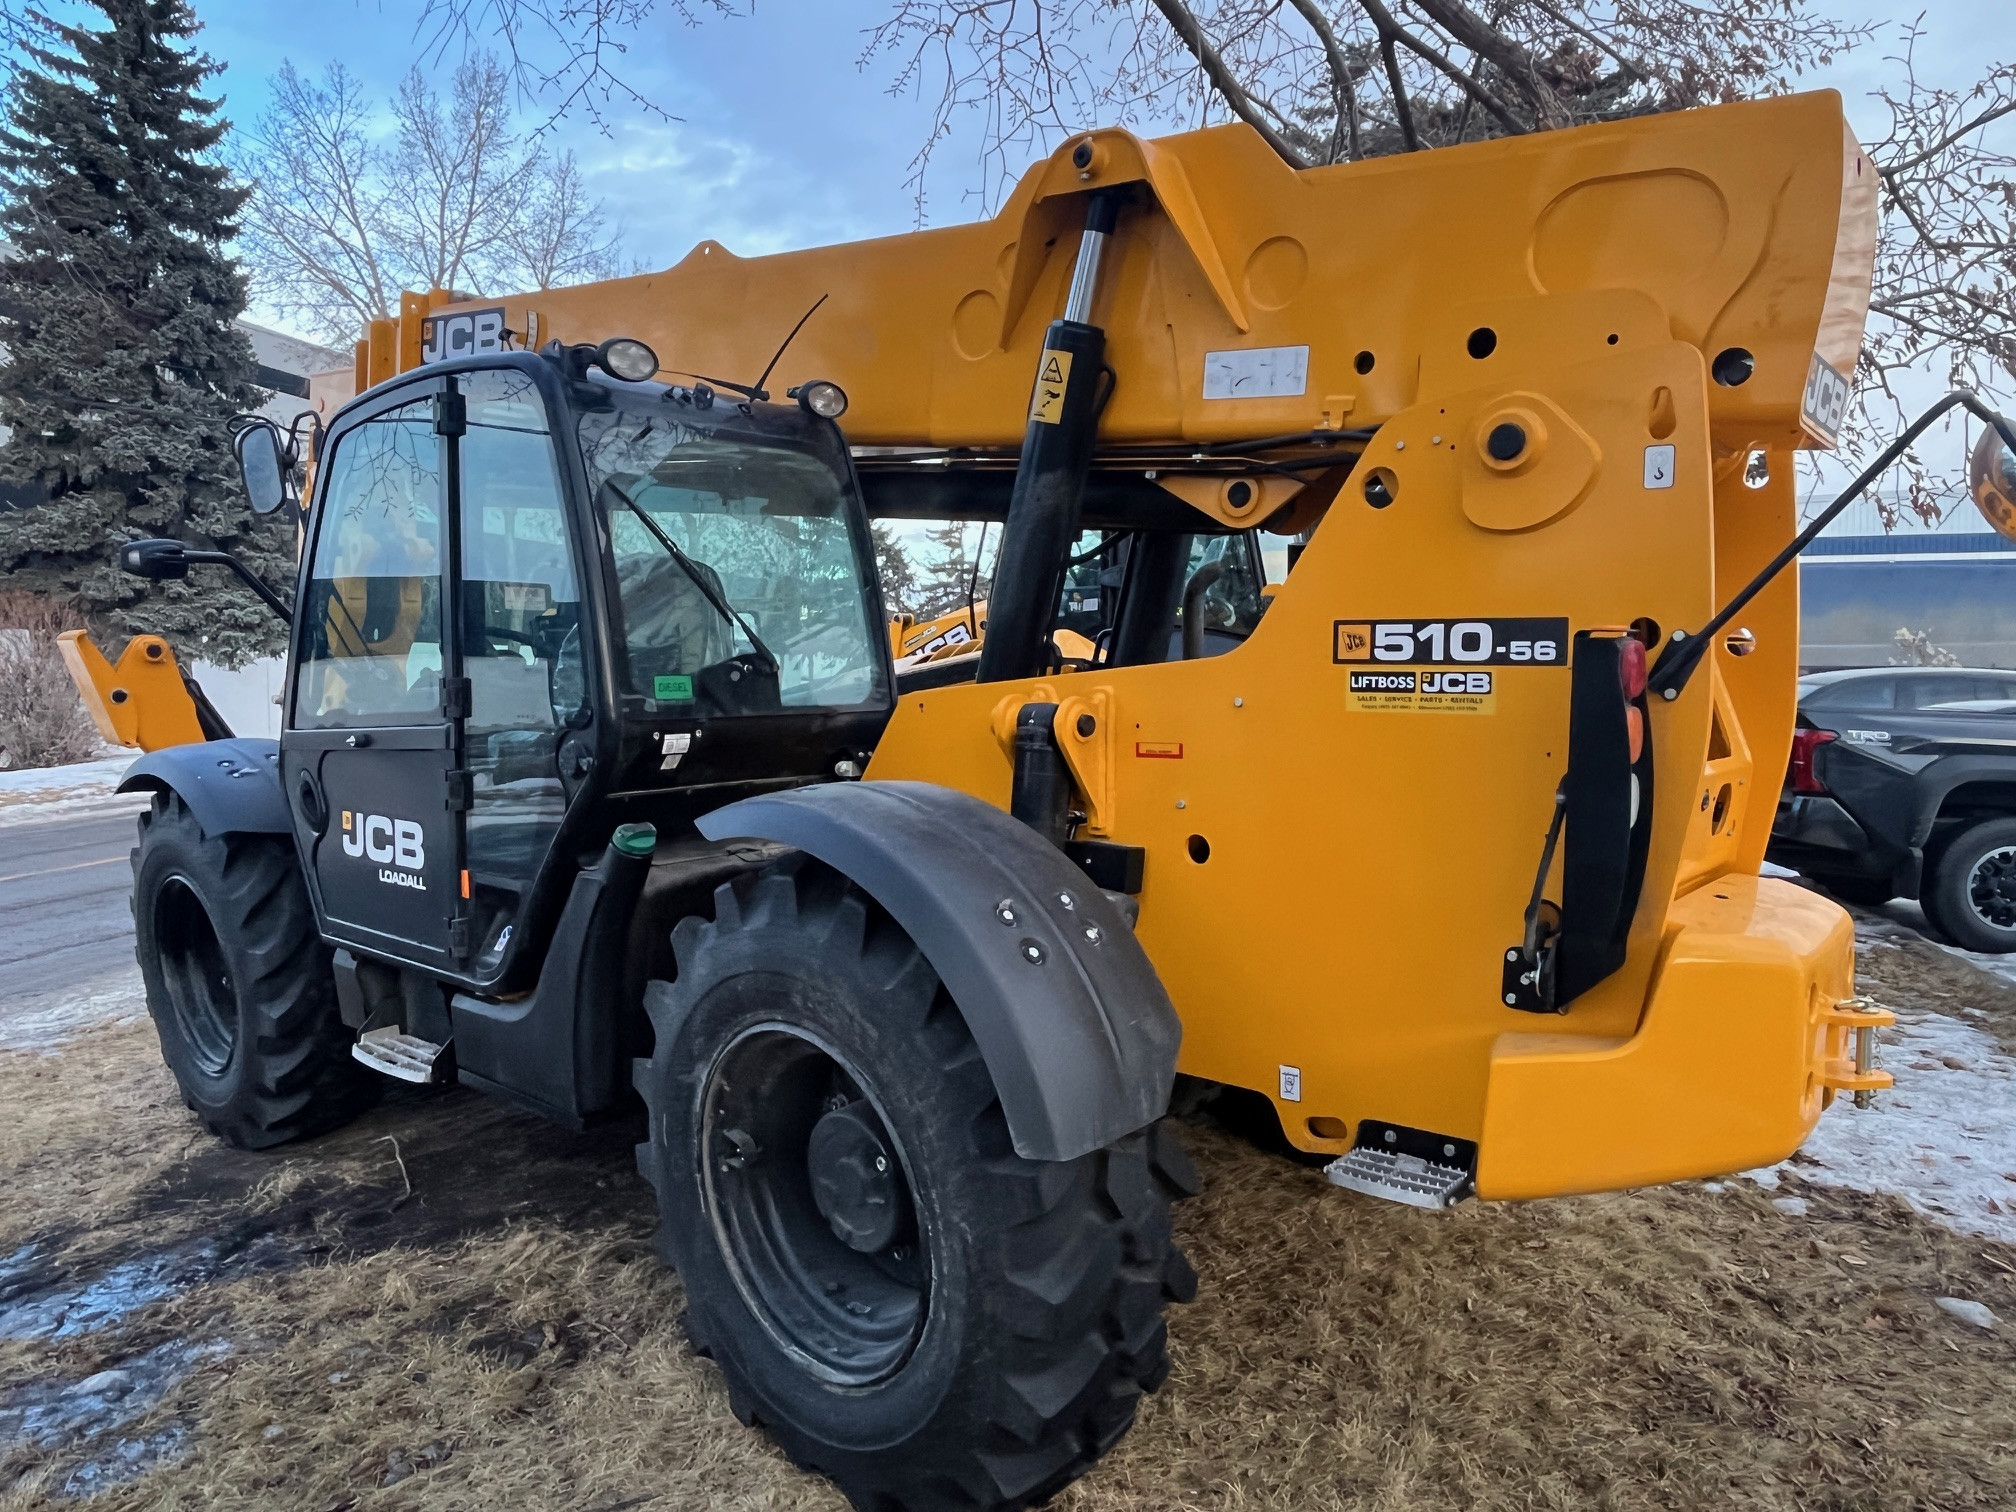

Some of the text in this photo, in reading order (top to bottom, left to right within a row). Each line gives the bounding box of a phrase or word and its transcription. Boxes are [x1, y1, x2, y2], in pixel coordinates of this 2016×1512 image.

[422, 312, 503, 363] JCB
[1805, 364, 1846, 431] JCB
[1373, 622, 1557, 662] 510-56
[658, 682, 689, 692] DIESEL
[1351, 675, 1415, 690] LIFTBOSS
[1422, 673, 1491, 693] JCB
[342, 812, 425, 870] JCB
[378, 868, 427, 891] LOADALL
